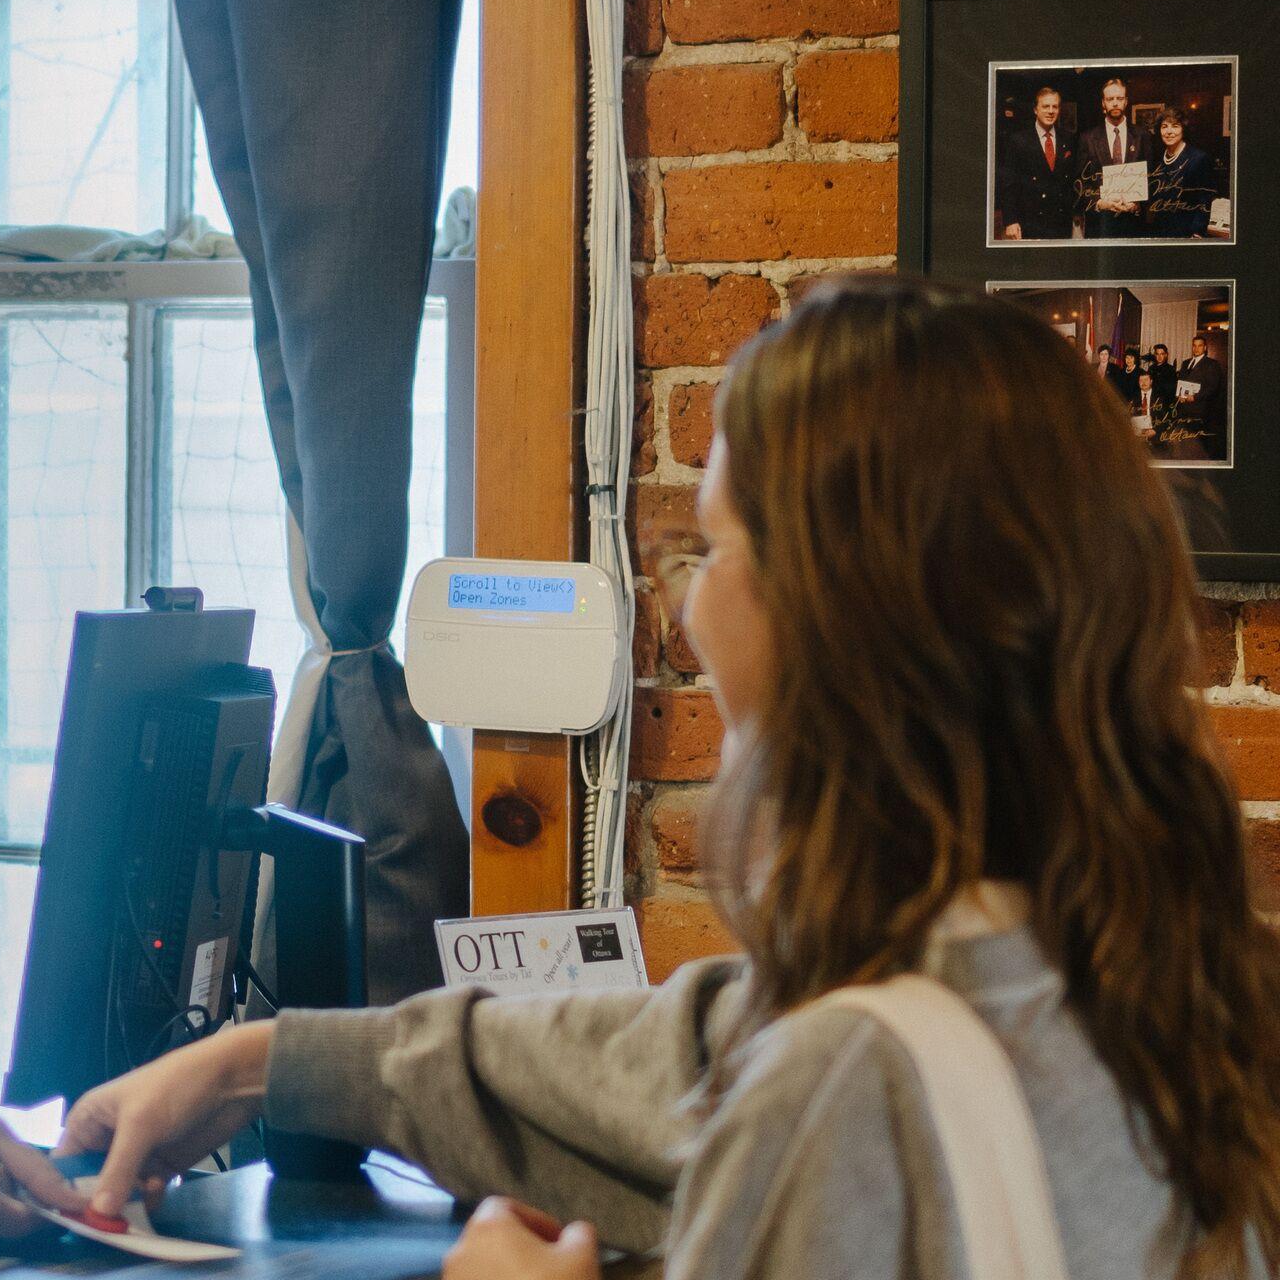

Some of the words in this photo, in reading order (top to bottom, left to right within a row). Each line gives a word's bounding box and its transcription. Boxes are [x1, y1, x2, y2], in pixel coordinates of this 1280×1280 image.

[453, 576, 497, 590] Scroll
[507, 578, 520, 591] to
[452, 590, 483, 604] Open
[490, 592, 527, 606] Zones
[454, 931, 526, 973] OTT
